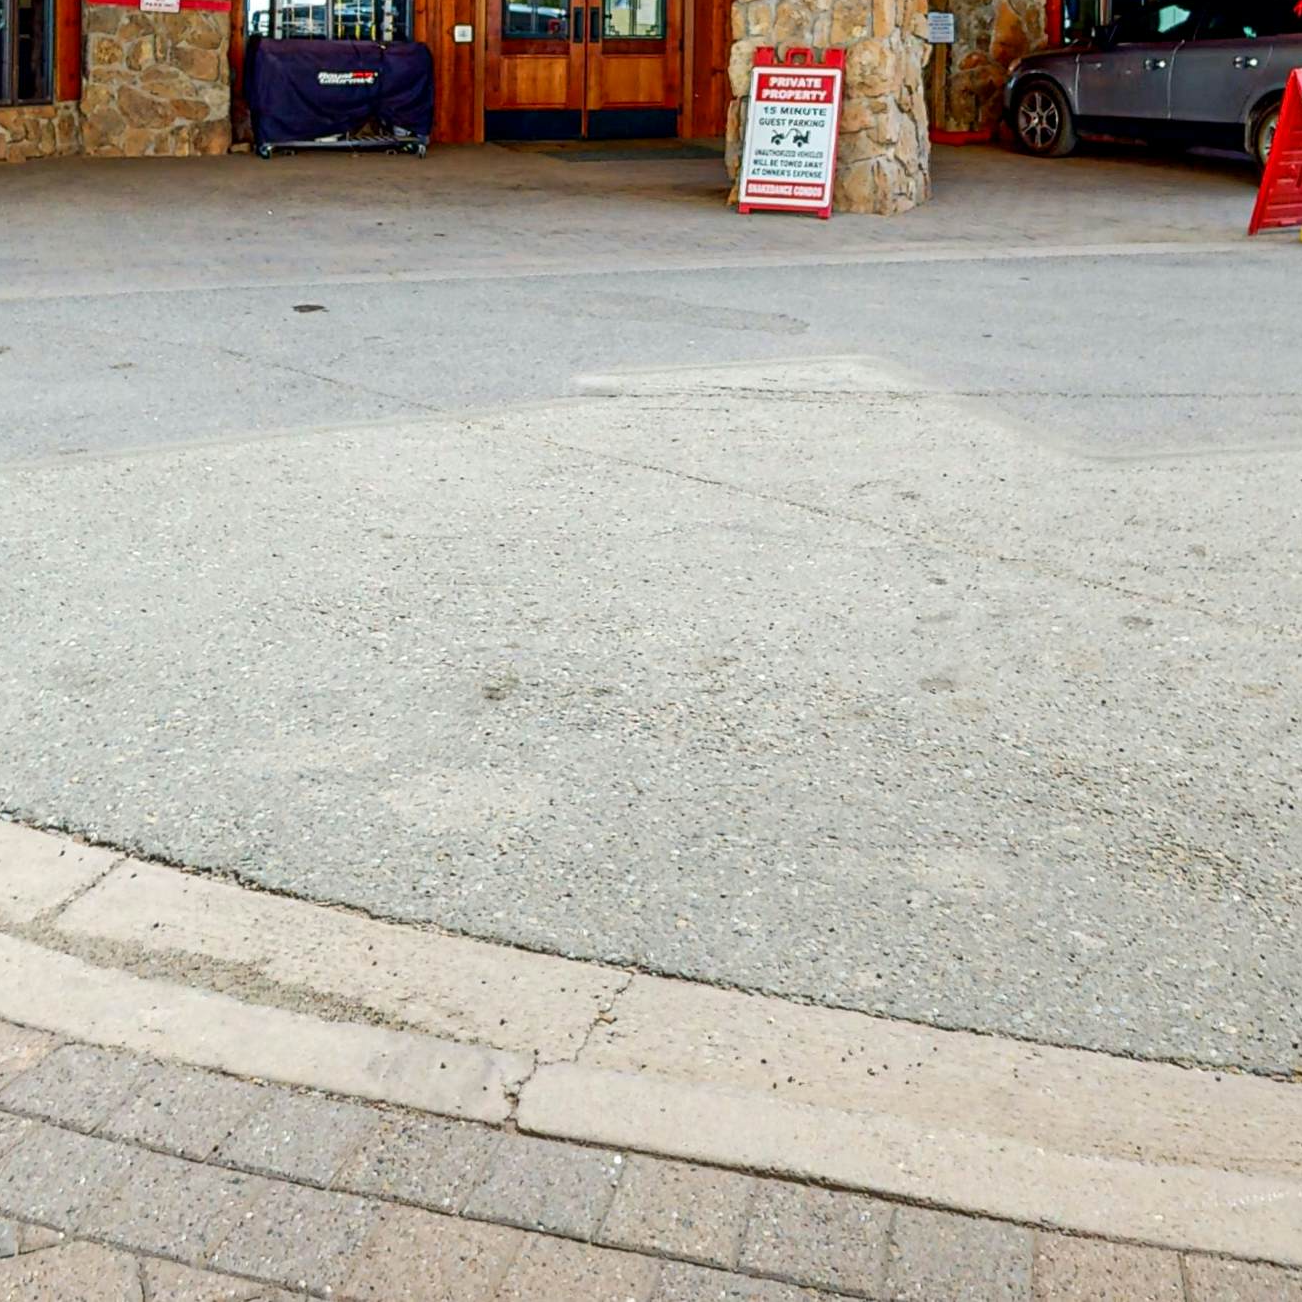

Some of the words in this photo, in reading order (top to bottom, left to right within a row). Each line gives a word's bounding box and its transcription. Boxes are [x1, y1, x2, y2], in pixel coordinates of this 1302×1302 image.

[769, 76, 823, 88] PRIVATE
[761, 89, 827, 101] PROPERTY
[763, 106, 777, 115] 15
[780, 107, 827, 116] MINUTE
[758, 117, 786, 126] GUEST
[788, 118, 826, 128] PARKING
[753, 159, 768, 167] WILL
[770, 159, 779, 167] BE
[780, 160, 803, 168] TOWED
[804, 161, 824, 169] AWAY
[751, 168, 760, 176] AT
[761, 169, 791, 177] OWNER'S
[793, 170, 822, 178] EXPENSE
